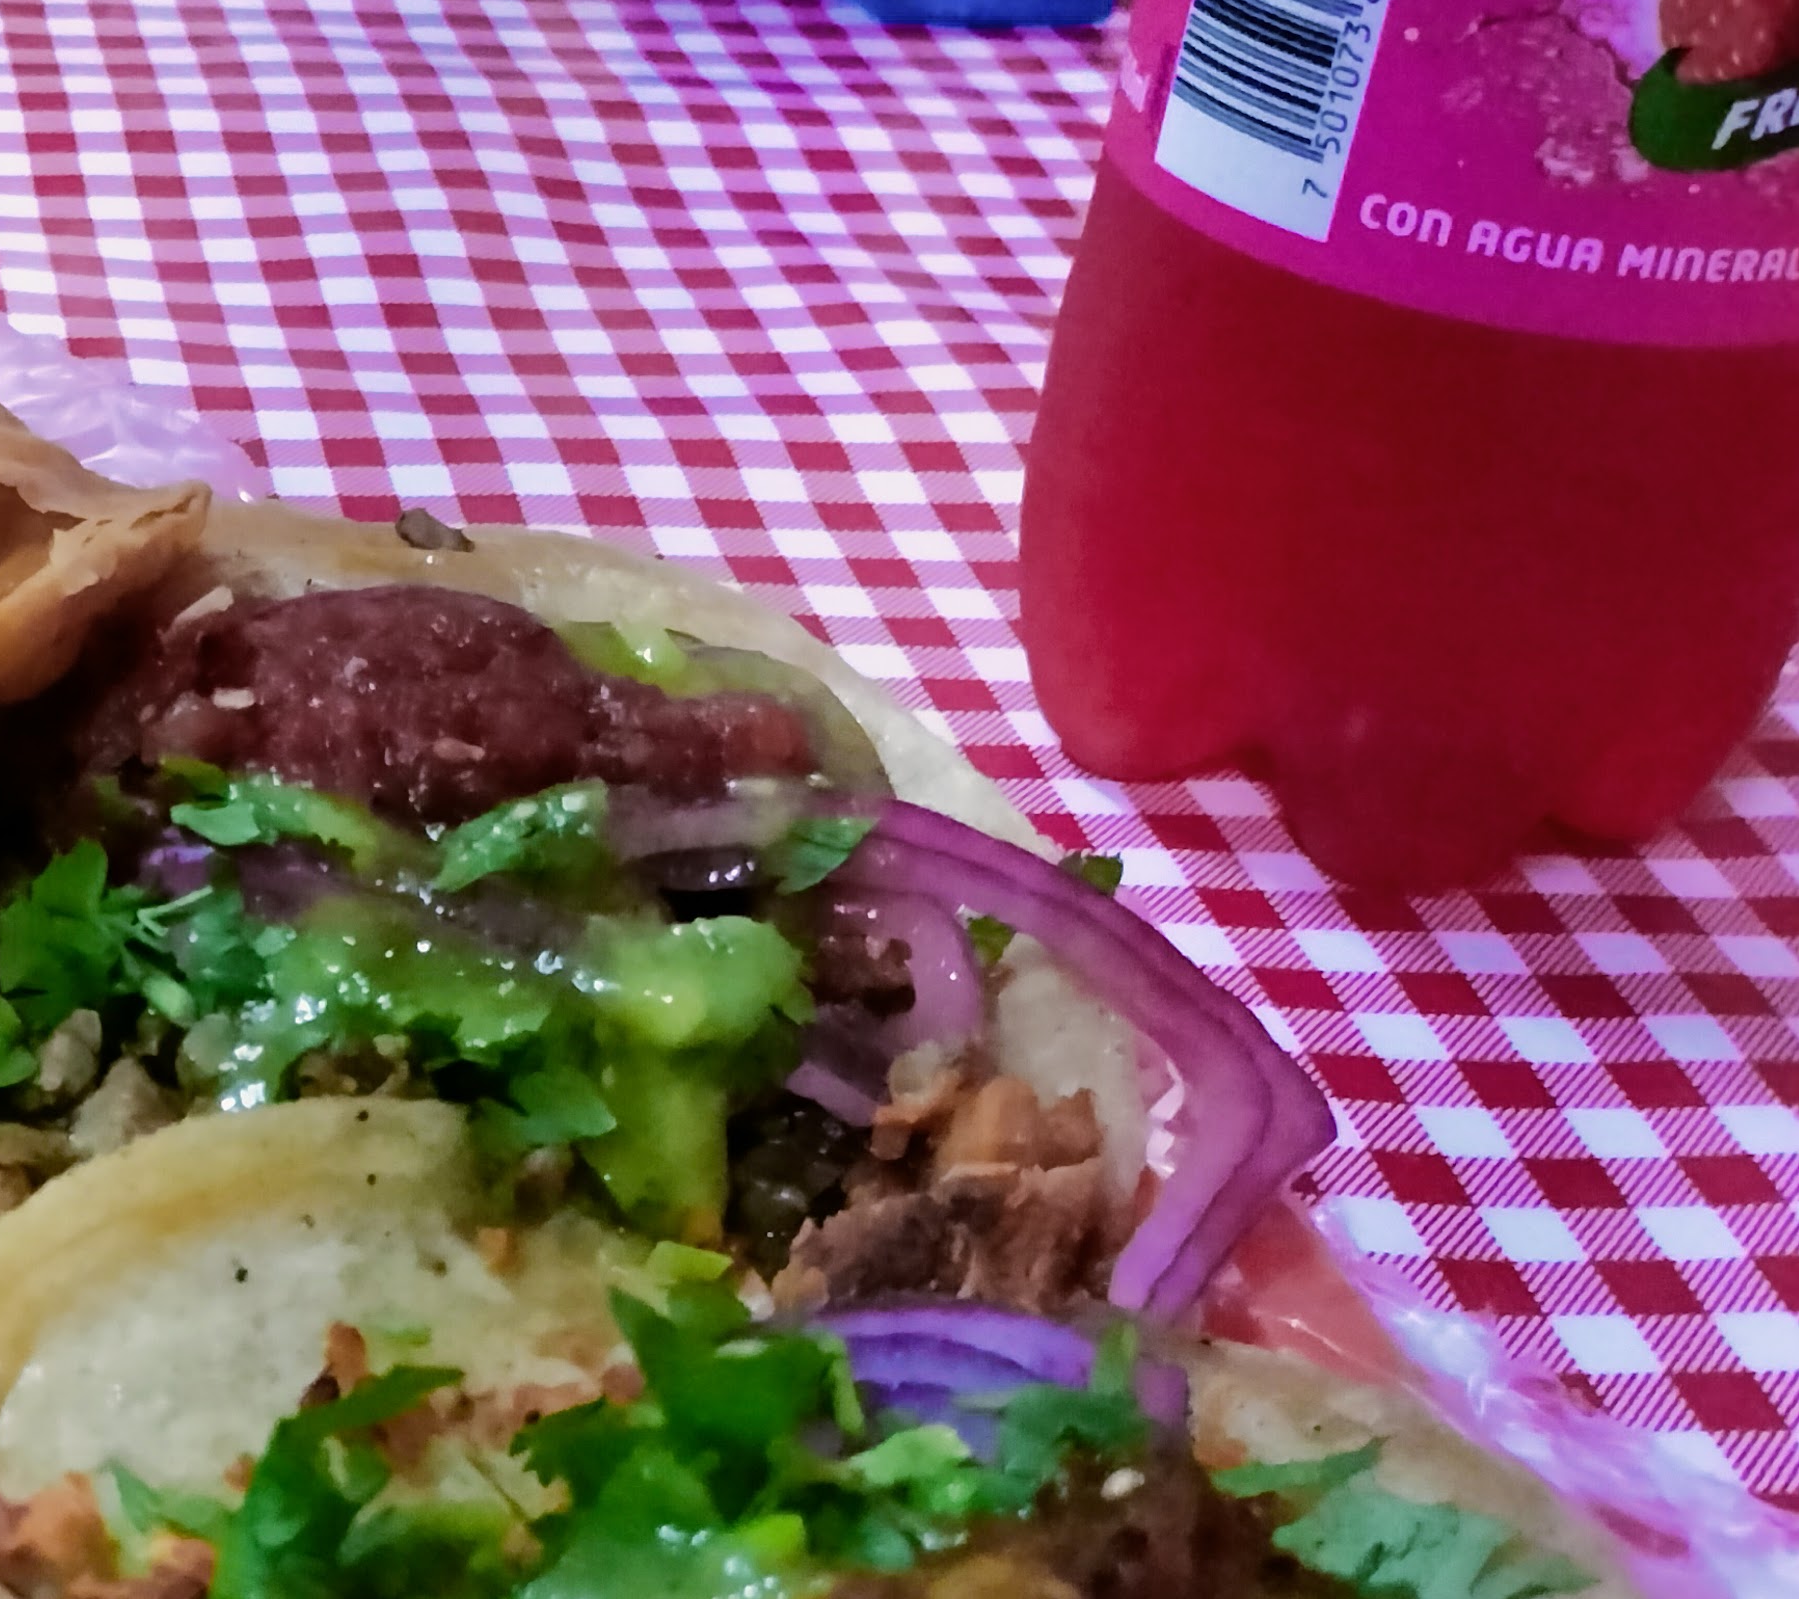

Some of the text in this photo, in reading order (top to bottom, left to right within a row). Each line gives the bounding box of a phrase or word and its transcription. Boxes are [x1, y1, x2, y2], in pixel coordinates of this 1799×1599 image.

[1316, 20, 1372, 154] 501073
[1711, 87, 1799, 150] FR
[1303, 177, 1330, 198] 7
[1359, 193, 1454, 247] CON
[1466, 222, 1603, 273] AGUA
